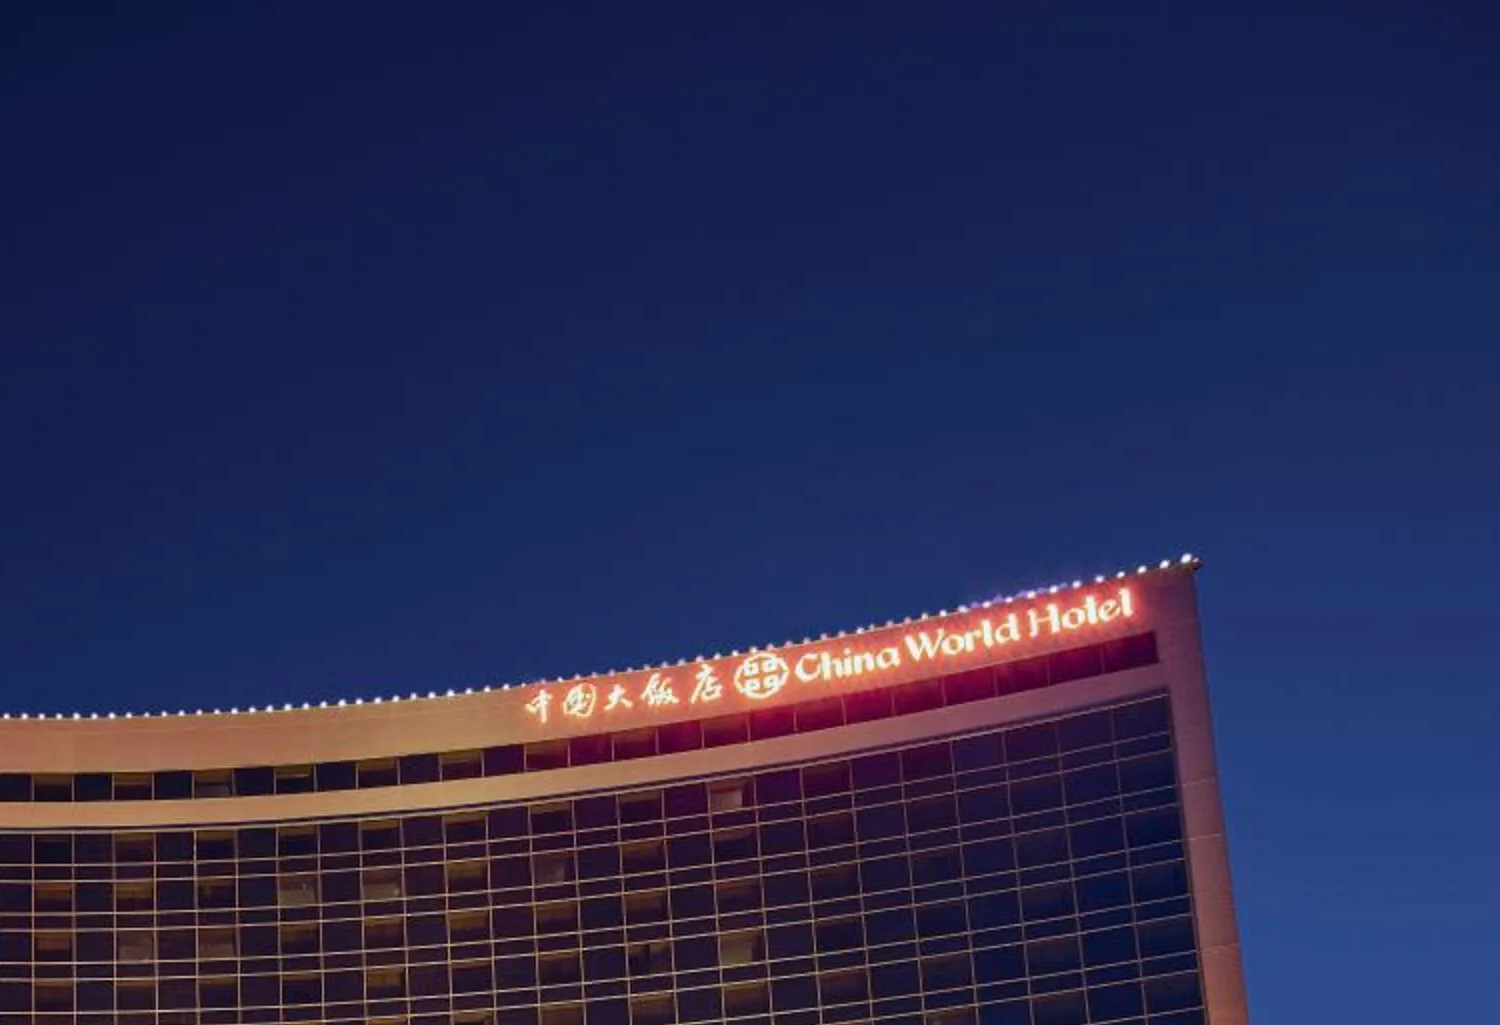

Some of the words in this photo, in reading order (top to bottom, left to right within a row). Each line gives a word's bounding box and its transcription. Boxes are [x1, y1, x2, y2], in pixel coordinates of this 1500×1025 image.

[795, 646, 901, 683] China
[905, 618, 1020, 662] World
[1027, 587, 1135, 638] Hotel
